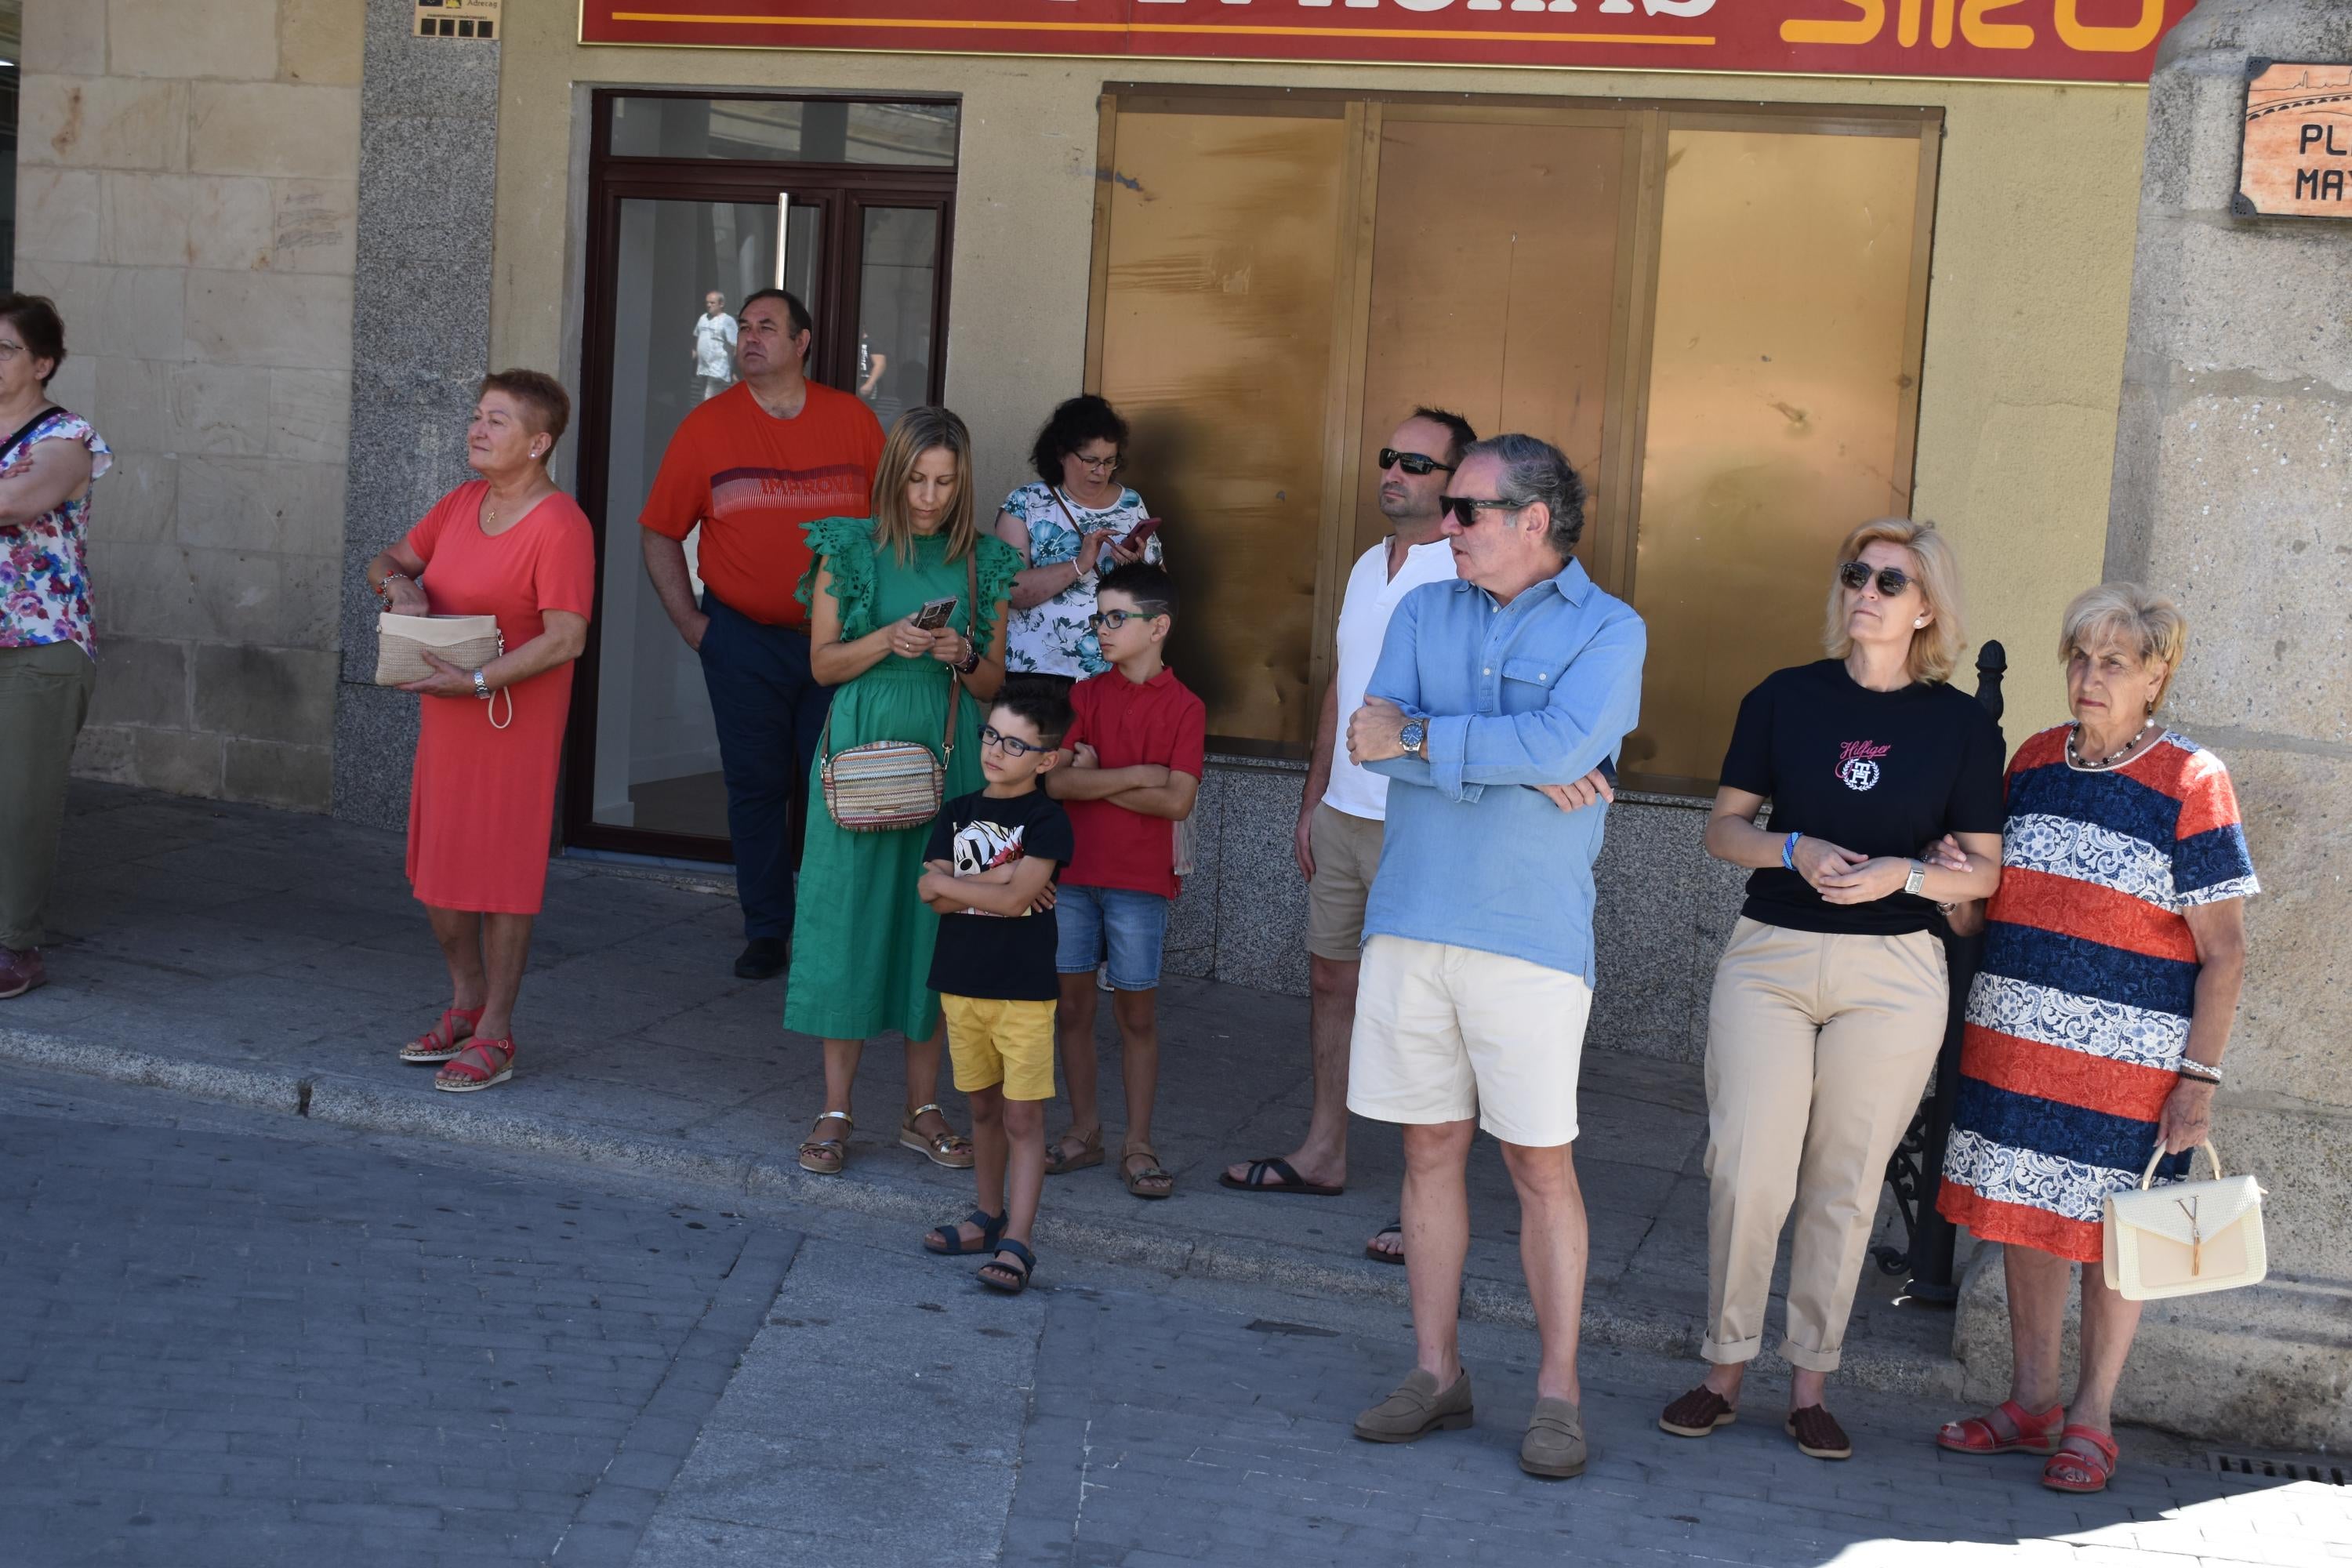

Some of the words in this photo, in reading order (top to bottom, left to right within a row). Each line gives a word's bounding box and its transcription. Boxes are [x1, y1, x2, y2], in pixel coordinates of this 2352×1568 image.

[2299, 124, 2352, 156] PL
[2295, 169, 2352, 201] MA
[1838, 739, 1891, 764] Hilfiger
